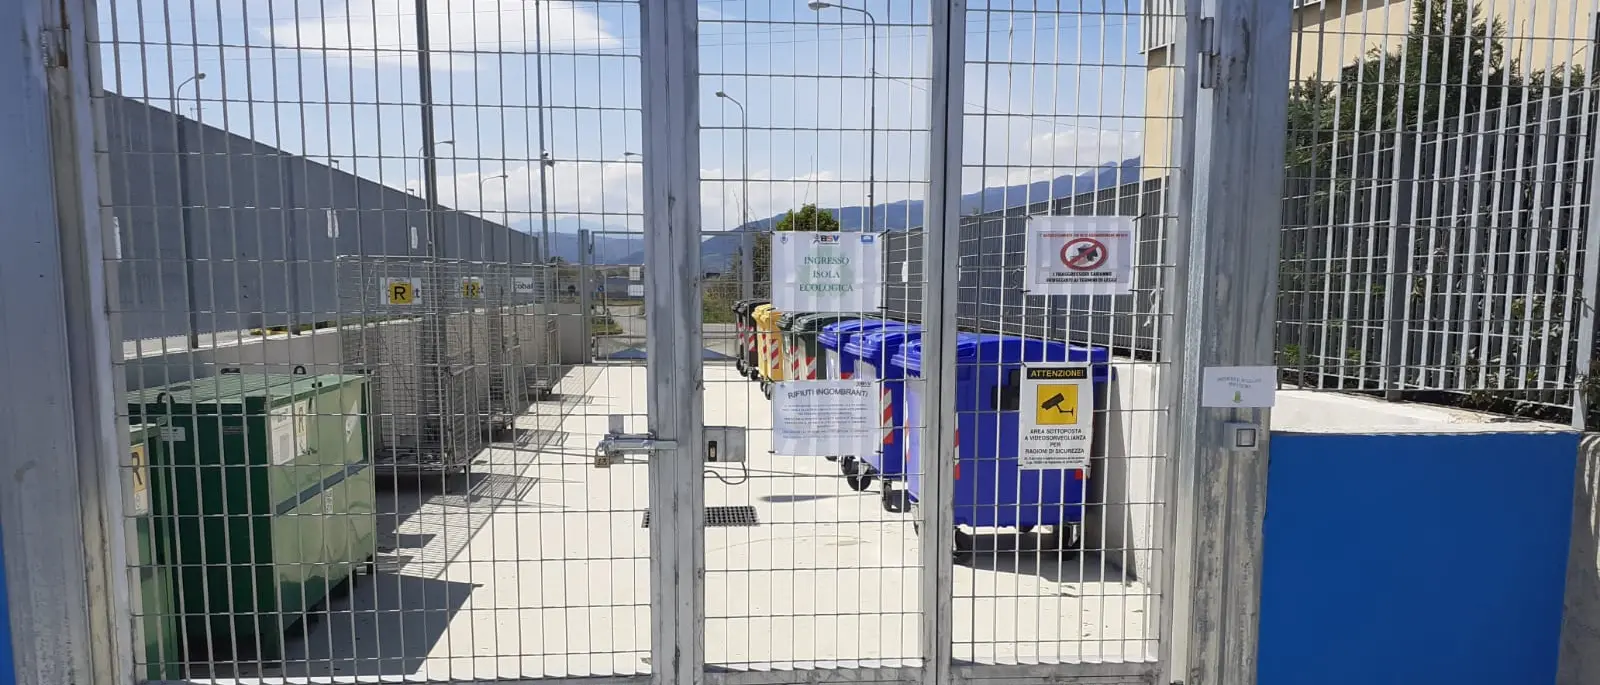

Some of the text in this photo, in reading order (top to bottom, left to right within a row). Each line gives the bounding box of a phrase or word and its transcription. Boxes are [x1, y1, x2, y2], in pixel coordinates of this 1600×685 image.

[804, 256, 850, 266] INGRESSO
[813, 270, 841, 279] ISOLA
[799, 283, 854, 292] ECOLOGICA
[394, 286, 406, 300] R
[1031, 369, 1084, 377] ATTENZIONE!
[787, 388, 869, 399] RIFIUTI INGOMBRANTI
